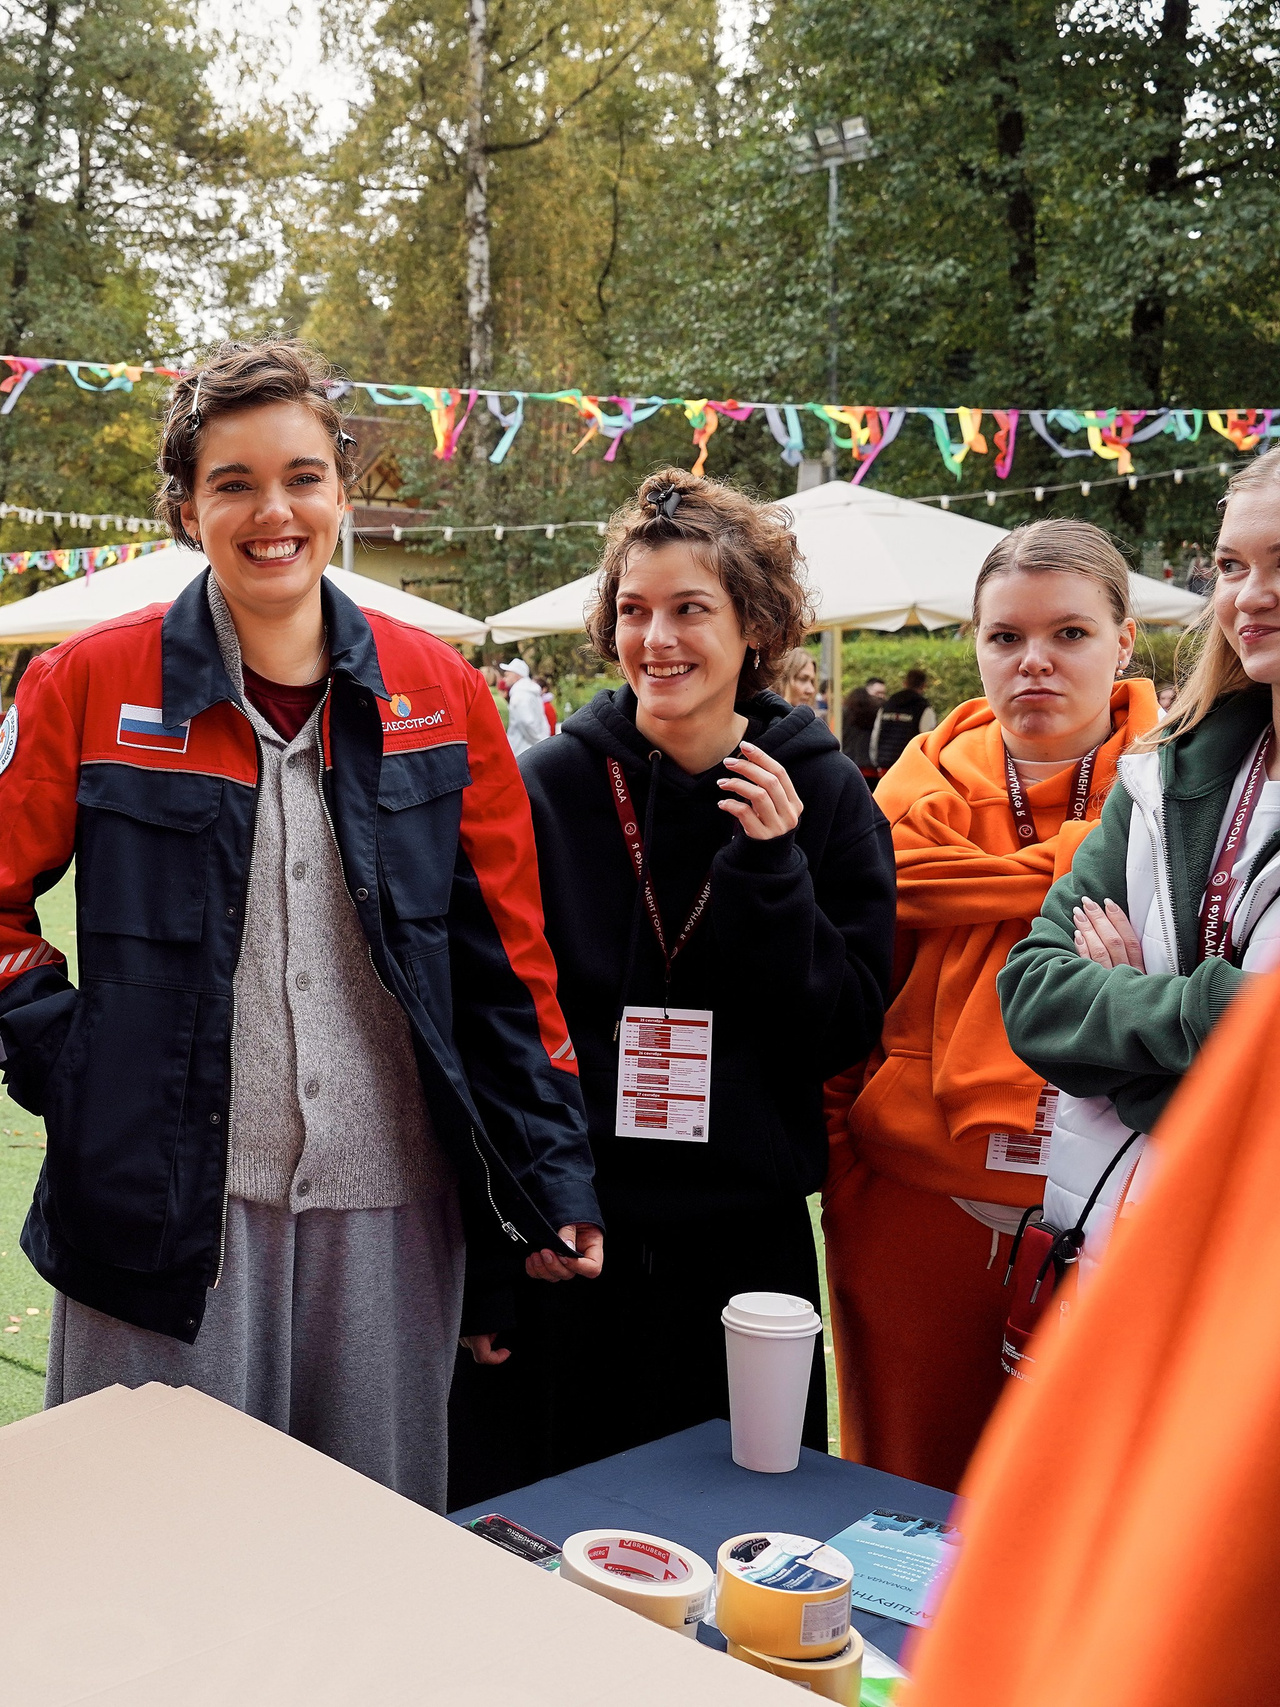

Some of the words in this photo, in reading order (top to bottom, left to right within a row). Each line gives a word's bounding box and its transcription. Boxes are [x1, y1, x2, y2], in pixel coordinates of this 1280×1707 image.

[381, 710, 443, 732] ЕЛЕССТРОЙ
[610, 760, 628, 804] ГОРОДА
[1225, 807, 1248, 852] ГОРОДА
[683, 878, 712, 932] ФУНДАМЕ
[1204, 904, 1220, 960] ФУНДАМ
[631, 1540, 667, 1560] BRAUBERG
[866, 1576, 913, 1592] КОМАНДА
[851, 1589, 934, 1619] АРШРУТН
